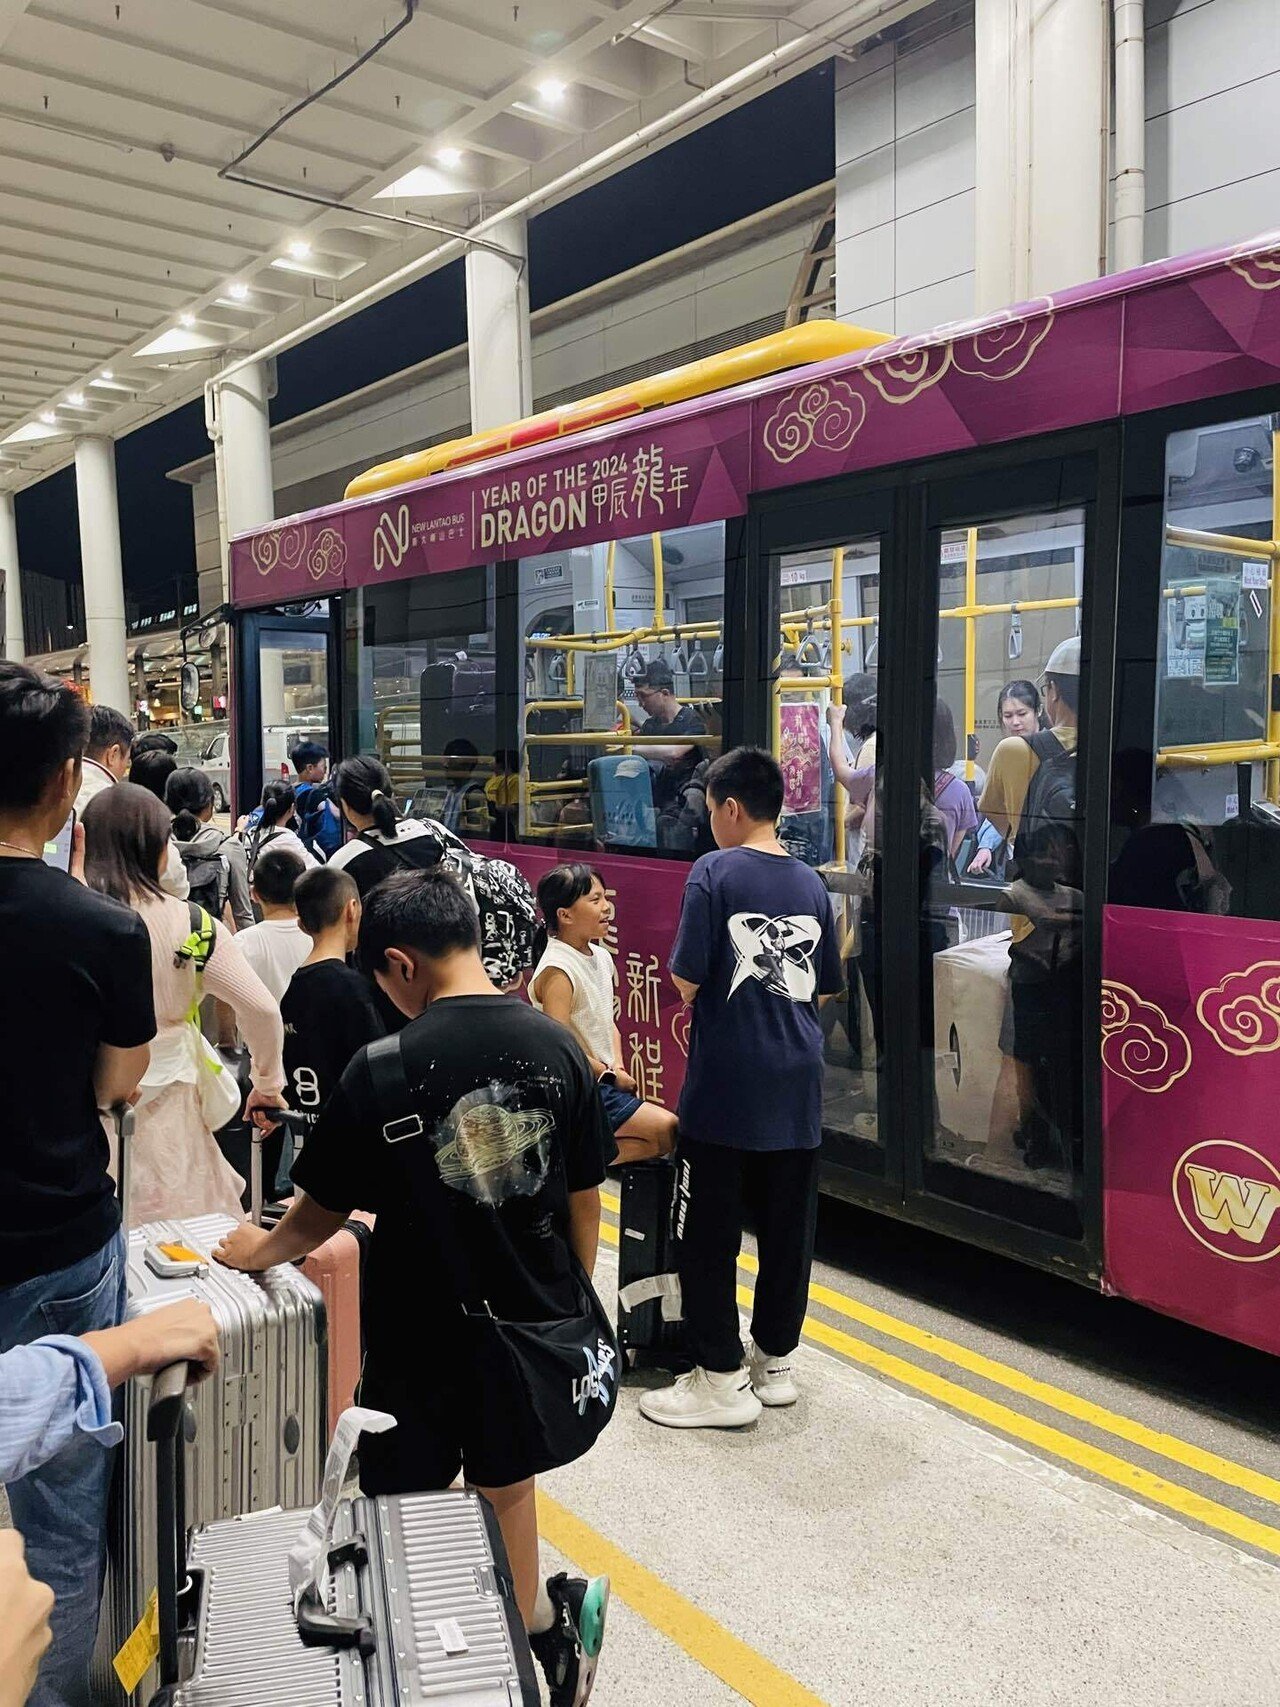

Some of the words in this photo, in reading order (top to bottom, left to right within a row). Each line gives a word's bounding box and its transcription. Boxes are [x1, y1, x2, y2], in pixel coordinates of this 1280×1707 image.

[592, 452, 628, 481] 2024
[481, 481, 521, 509] YEAR
[526, 474, 548, 498] OF
[553, 463, 587, 491] THE
[411, 522, 427, 534] NEW
[426, 516, 452, 531] LANTAO
[451, 512, 466, 525] BUS
[481, 490, 587, 548] DRAGON
